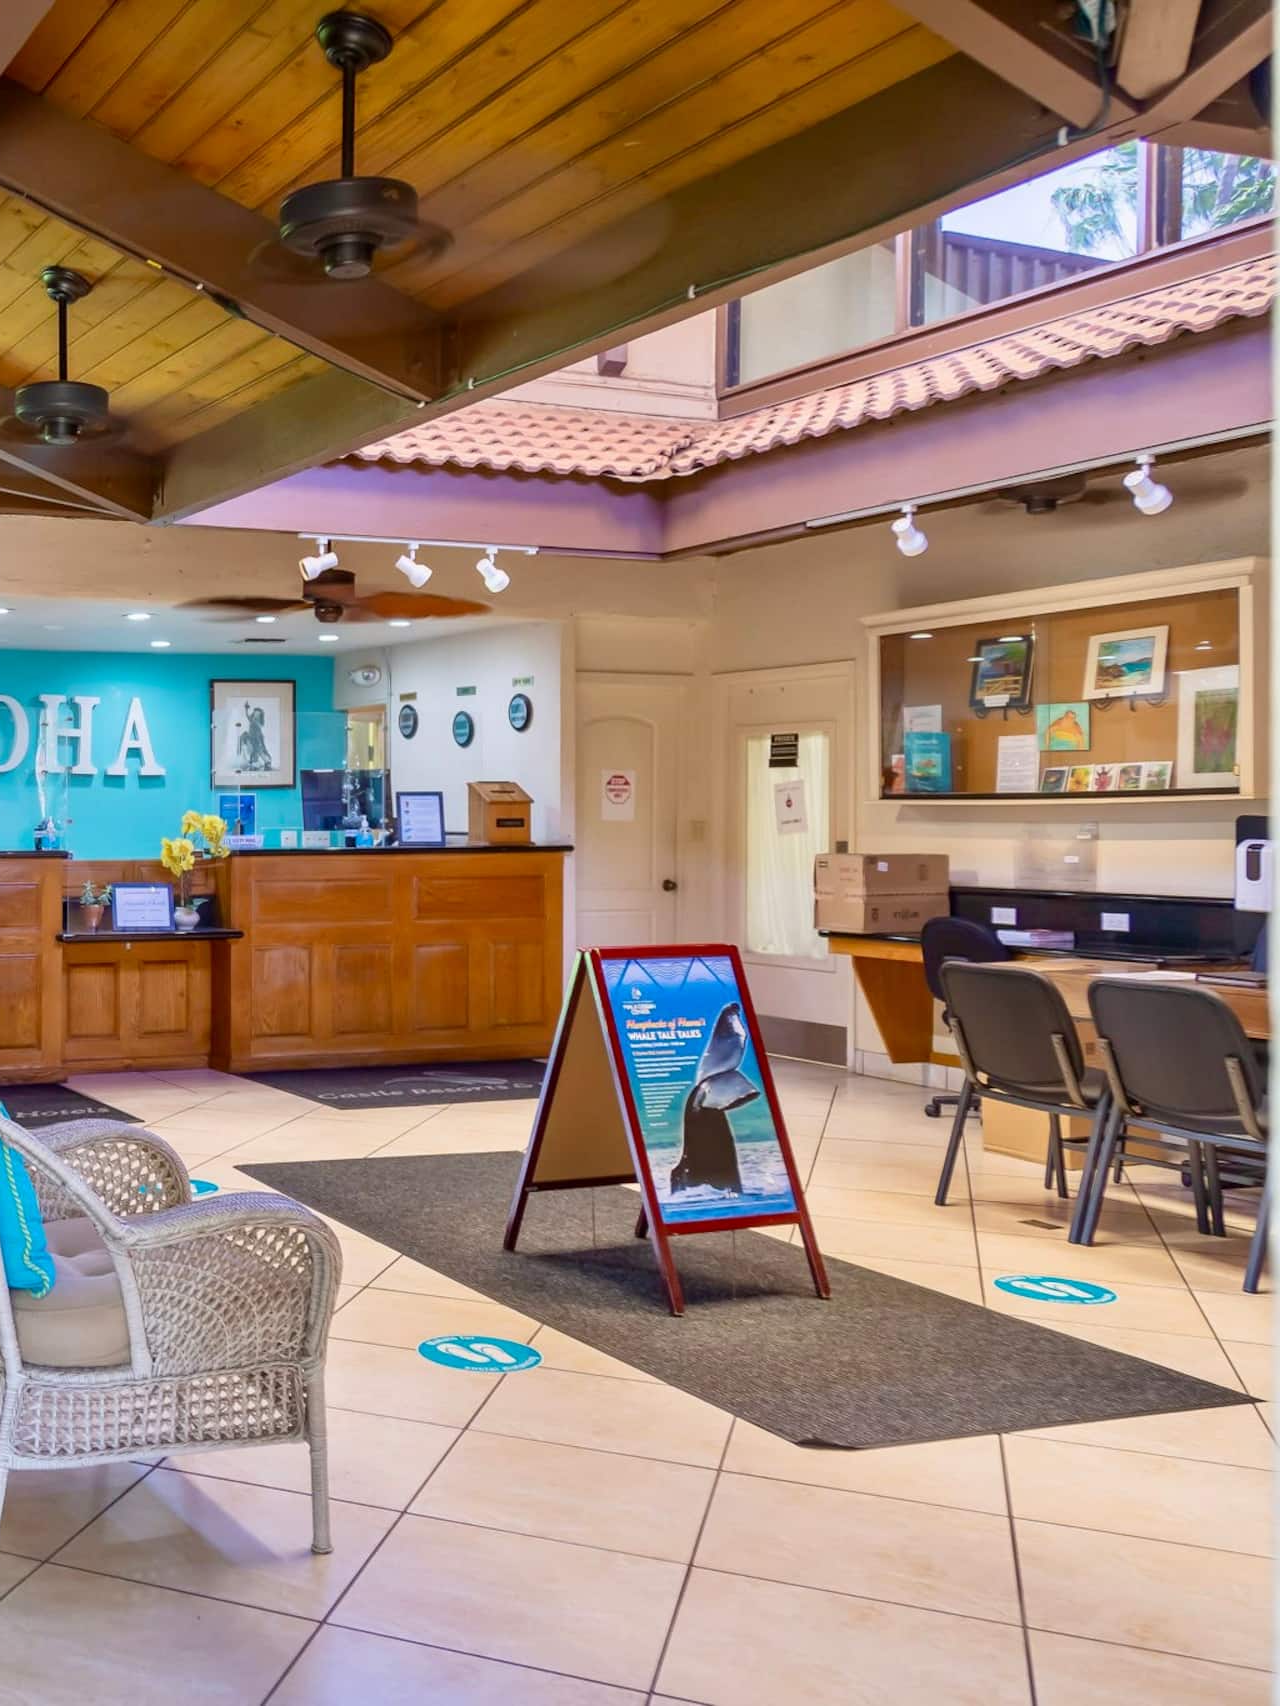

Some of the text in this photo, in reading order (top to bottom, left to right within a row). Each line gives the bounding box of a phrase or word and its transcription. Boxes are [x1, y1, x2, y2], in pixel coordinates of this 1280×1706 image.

[628, 1029, 702, 1040] WHALE TALE TALKS
[317, 1087, 404, 1101] Castle
[411, 1083, 509, 1095] Resorts
[15, 1106, 111, 1119] Hotels
